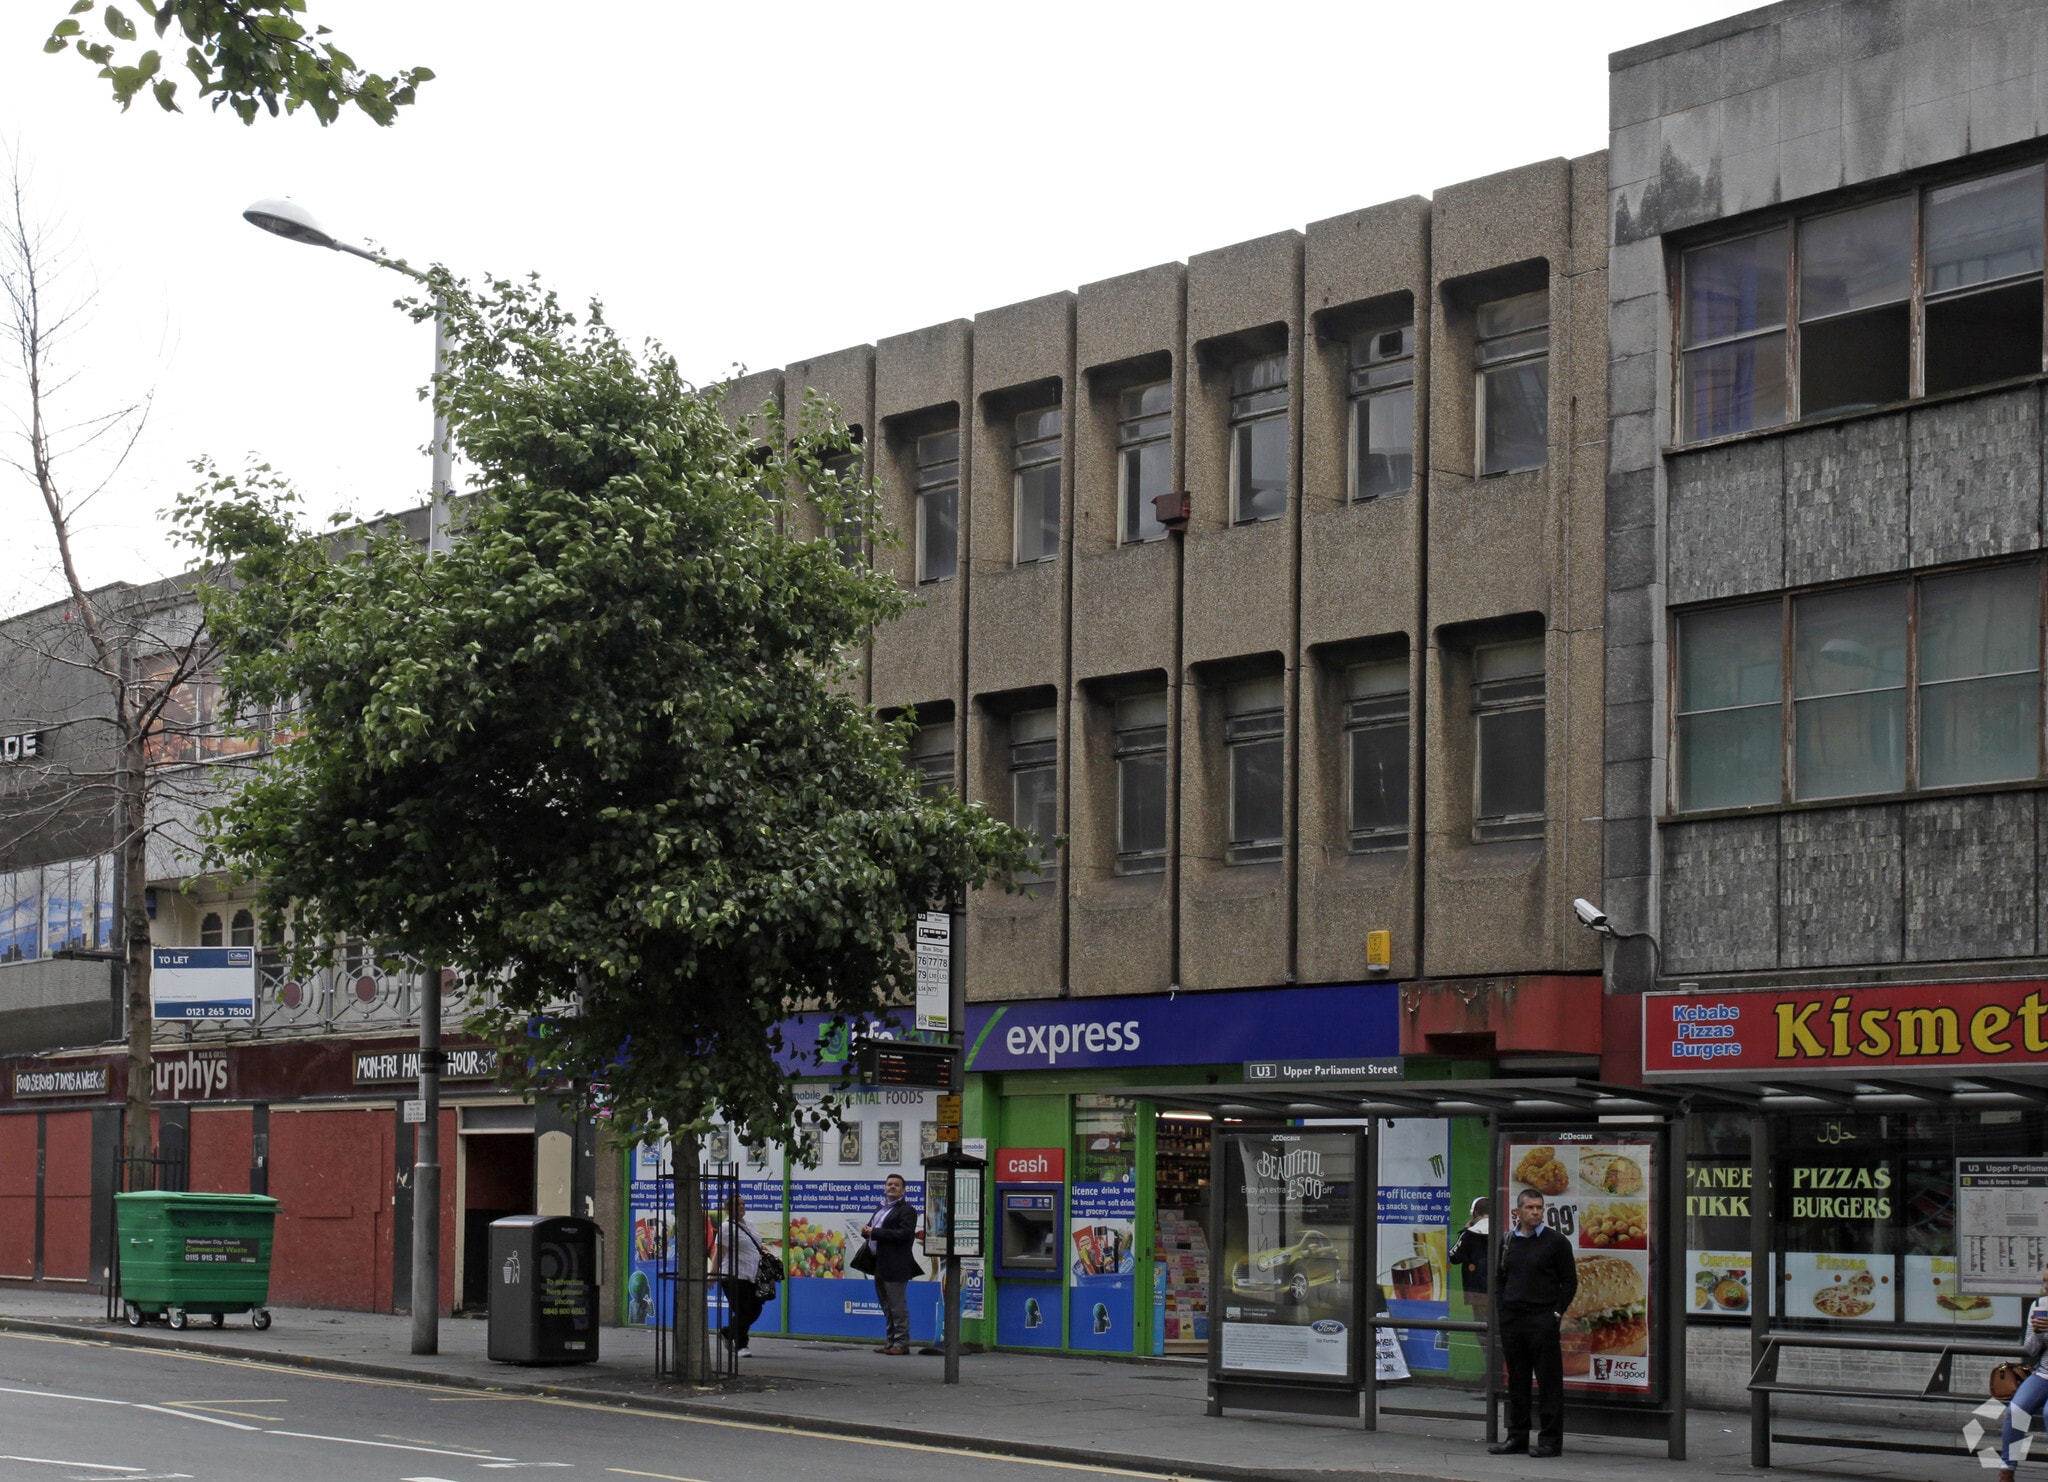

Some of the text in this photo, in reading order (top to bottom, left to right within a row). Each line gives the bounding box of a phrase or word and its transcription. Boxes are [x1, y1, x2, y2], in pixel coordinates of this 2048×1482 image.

[0, 732, 36, 761] DE
[159, 956, 189, 964] TO LET
[918, 957, 948, 967] 76 77 78
[918, 971, 927, 979] 79
[186, 1008, 251, 1016] 0121 265 7500
[1673, 1004, 1740, 1021] Kebabs
[1774, 989, 2048, 1059] Kismet
[1678, 1023, 1734, 1039] Pizzas
[1006, 1021, 1140, 1064] express
[1672, 1041, 1742, 1060] Burgers
[357, 1055, 397, 1079] MON-FRI
[448, 1051, 479, 1075] HOUR
[1257, 1065, 1398, 1078] U3 Upper Parliament Street
[150, 1051, 228, 1099] urphys
[886, 1091, 923, 1104] FOODS
[1009, 1155, 1047, 1173] cash
[1257, 1149, 1324, 1181] BEAUTIFUL
[1986, 1165, 2010, 1173] Upper
[1792, 1167, 1891, 1189] PIZZAS
[631, 1182, 639, 1190] off
[754, 1183, 763, 1191] off
[818, 1183, 828, 1191] off
[829, 1183, 851, 1191] licence
[1072, 1186, 1098, 1196] licence
[1101, 1186, 1120, 1194] drinks
[1386, 1189, 1399, 1199] off
[1400, 1189, 1432, 1199] licence
[1687, 1196, 1772, 1217] TIKK
[1792, 1197, 1891, 1220] BURGERS
[1417, 1214, 1445, 1223] grocery
[1317, 1322, 1338, 1332] Ford
[1615, 1362, 1637, 1370] KFC
